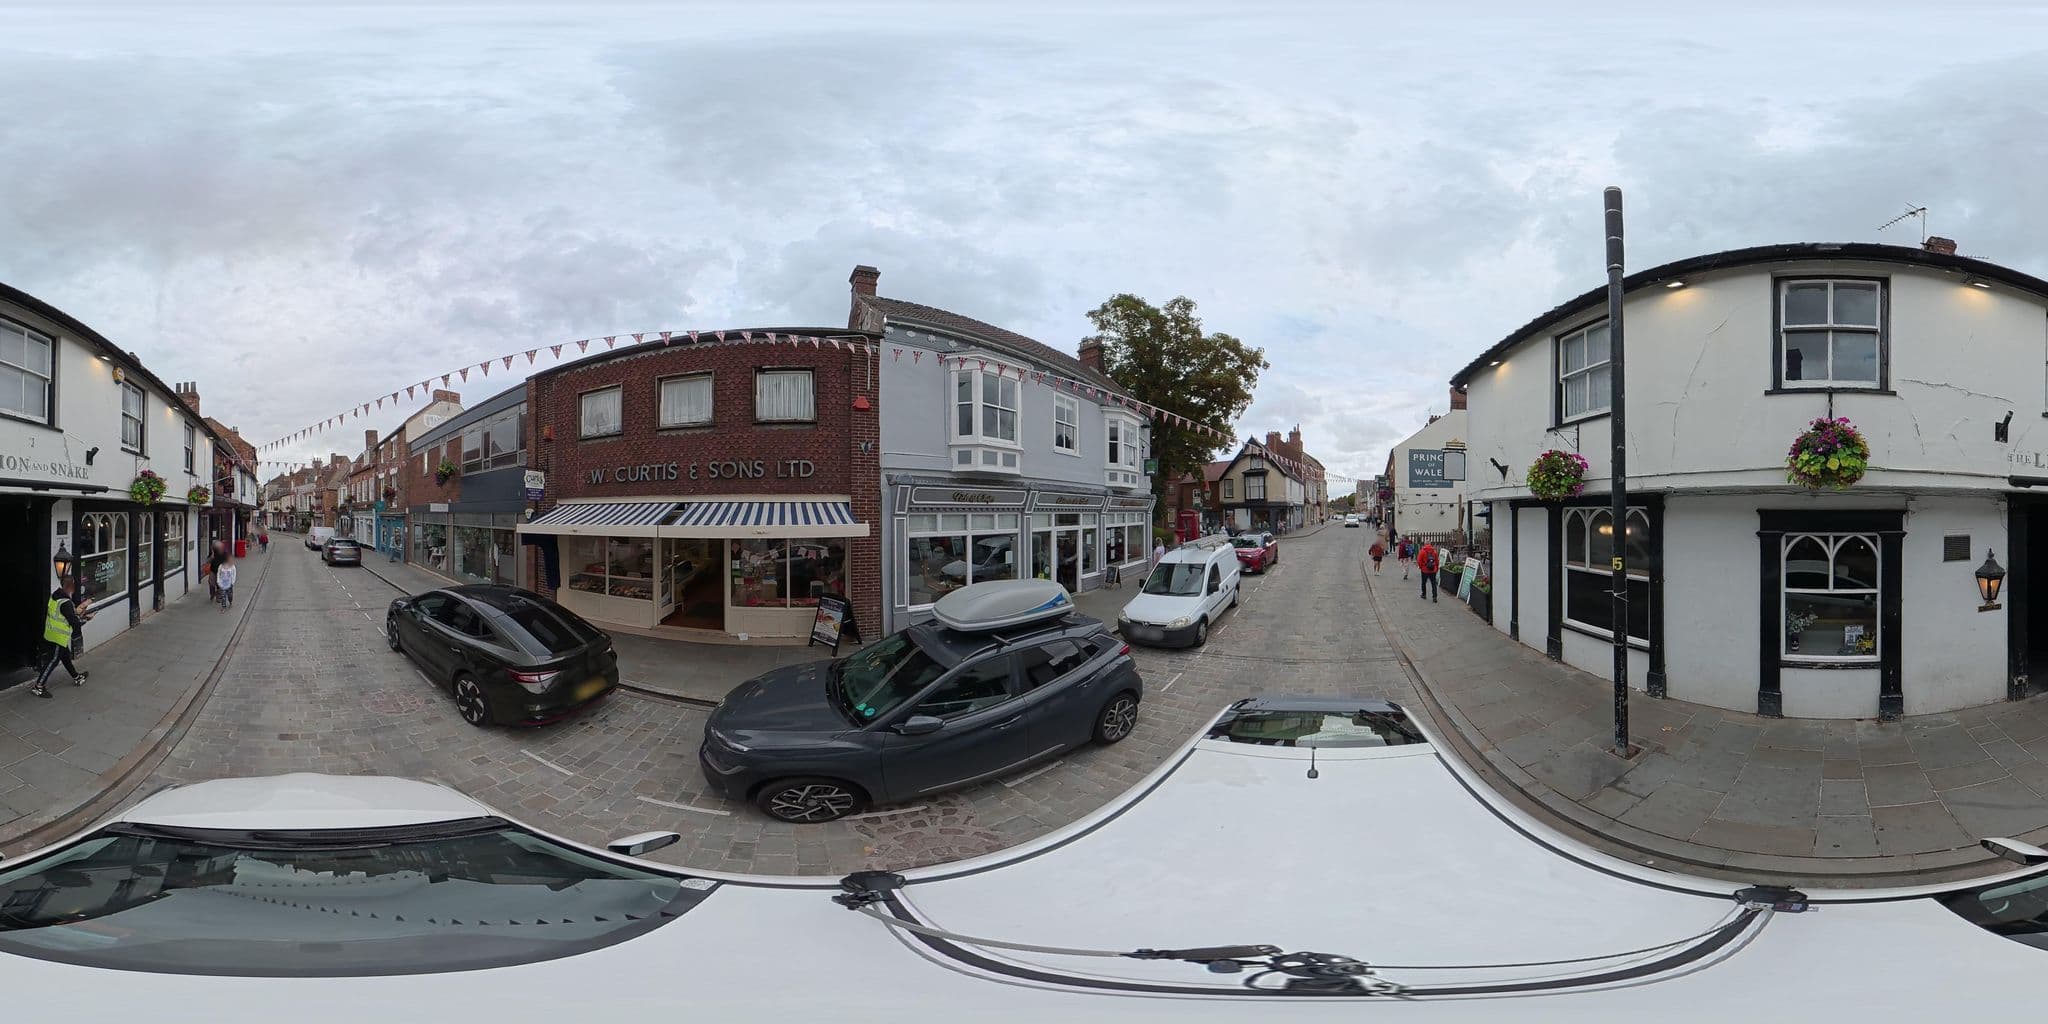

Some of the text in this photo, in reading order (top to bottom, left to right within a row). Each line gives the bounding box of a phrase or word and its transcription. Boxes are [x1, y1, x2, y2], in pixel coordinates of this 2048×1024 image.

[1413, 453, 1443, 462] PRINC
[32, 463, 48, 471] AND
[50, 462, 89, 480] SNAKE
[615, 462, 678, 482] CURTIS
[708, 460, 765, 480] SONS
[776, 460, 815, 479] LTD
[1414, 468, 1443, 477] WALE
